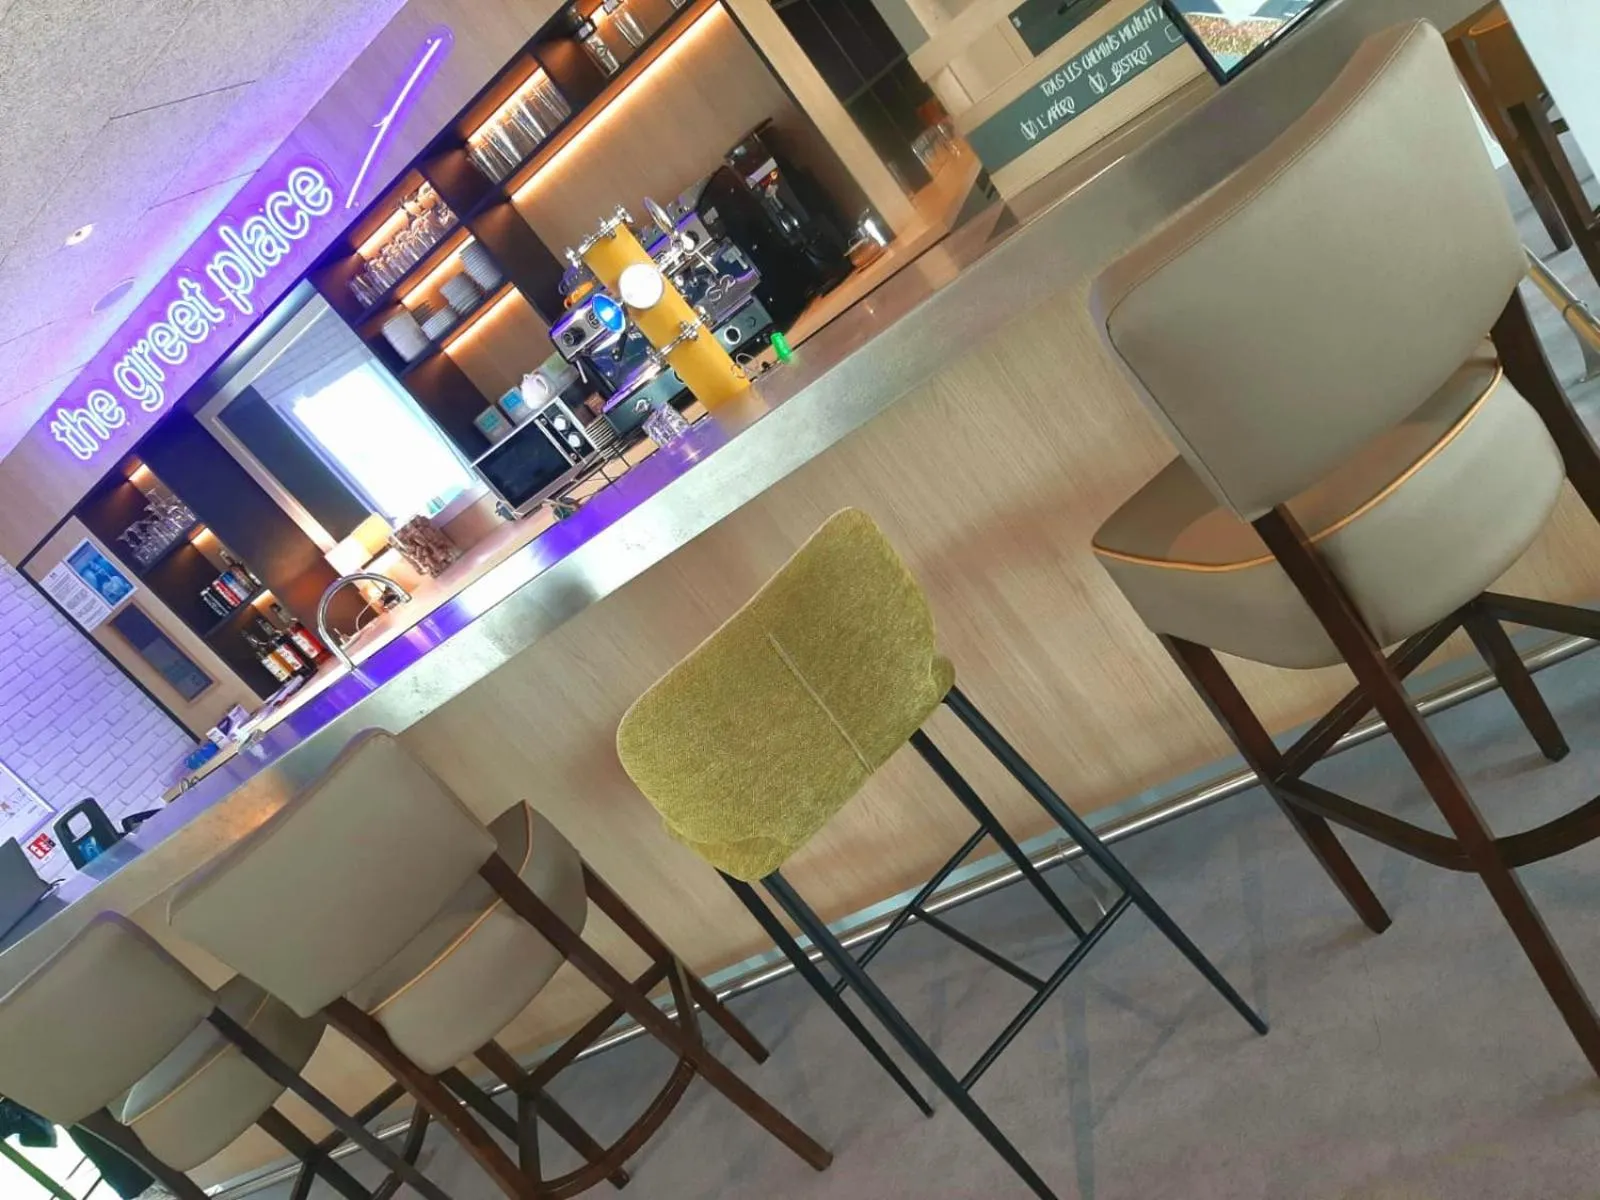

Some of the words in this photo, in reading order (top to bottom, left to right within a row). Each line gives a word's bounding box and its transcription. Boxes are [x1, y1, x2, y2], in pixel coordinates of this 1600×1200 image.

[1110, 40, 1153, 86] BISTROT
[51, 388, 127, 460] the
[113, 278, 223, 412] greet
[207, 166, 333, 314] place
